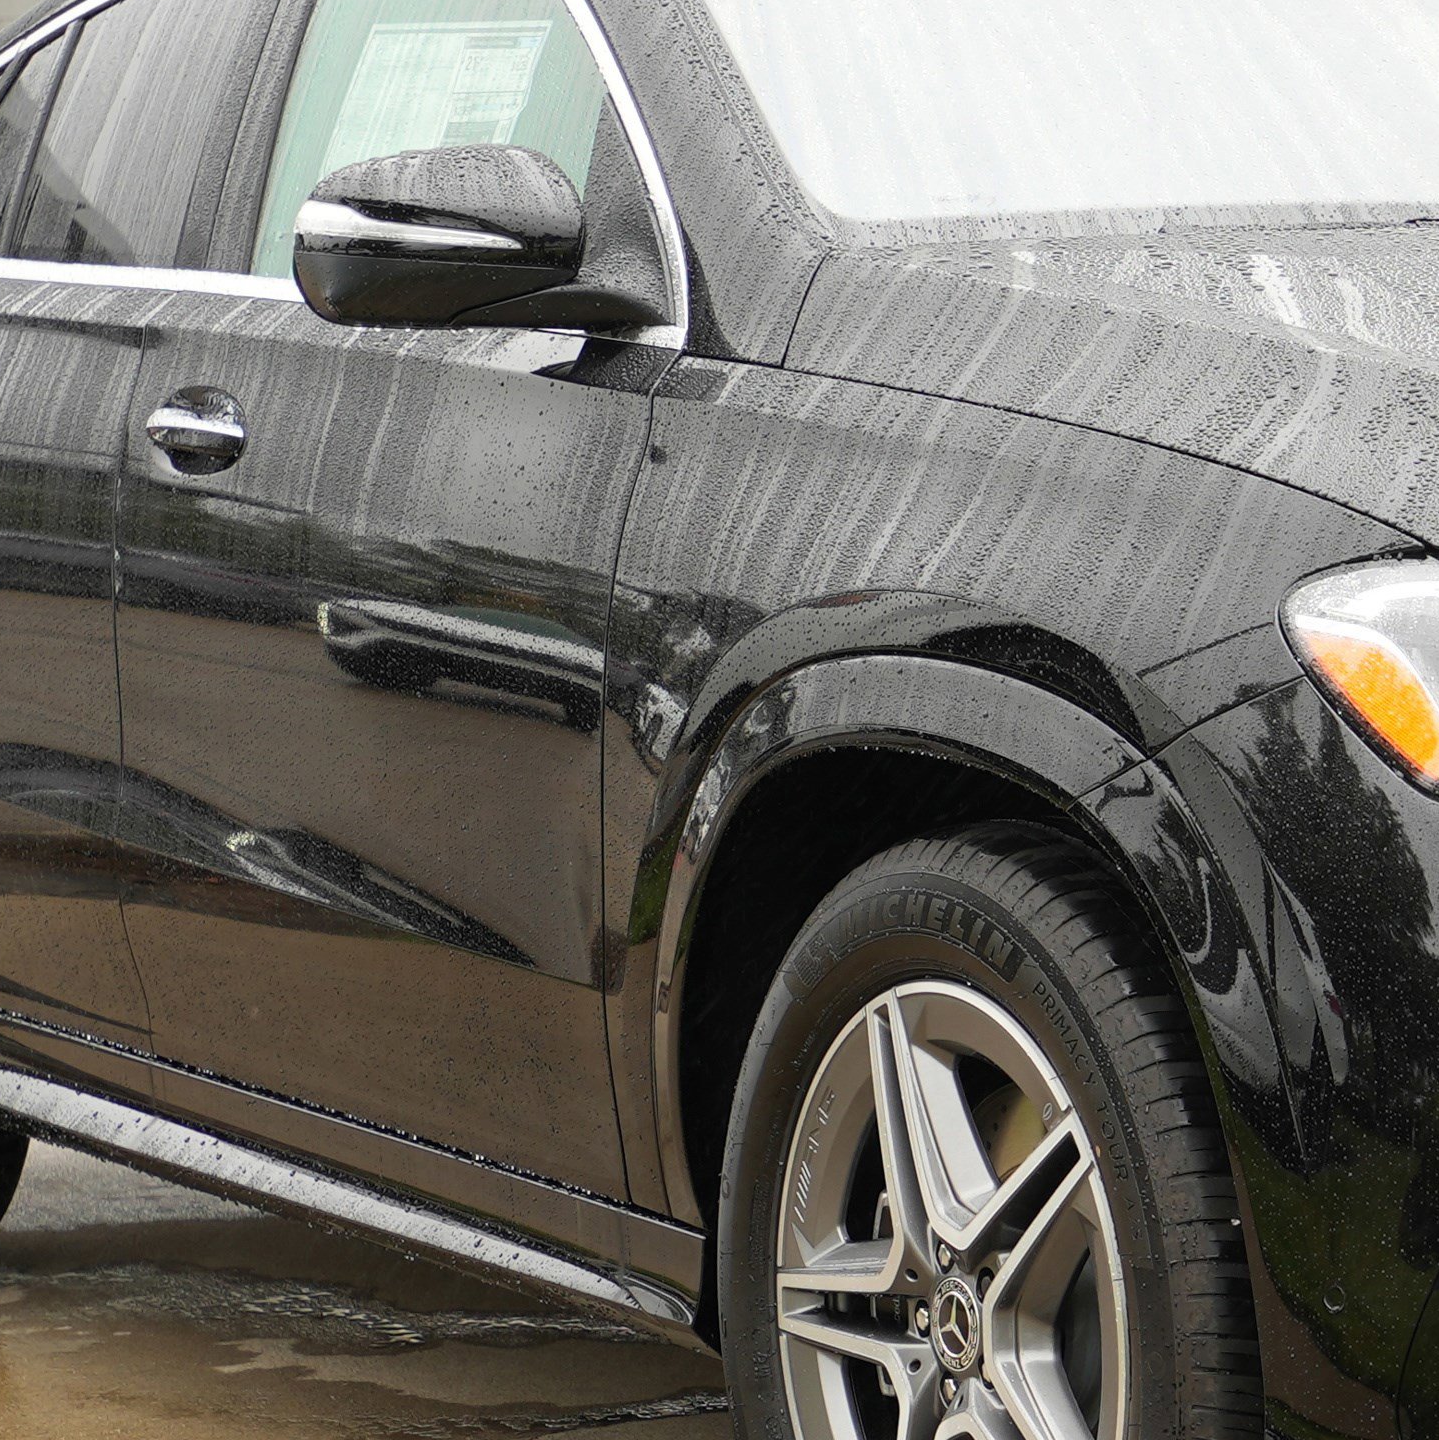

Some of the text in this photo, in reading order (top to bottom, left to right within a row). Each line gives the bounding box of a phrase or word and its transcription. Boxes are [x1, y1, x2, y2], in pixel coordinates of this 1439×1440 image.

[829, 893, 1014, 970] MICHELIN
[1032, 981, 1097, 1086] PRIMACY
[1096, 1101, 1129, 1182] TOUR
